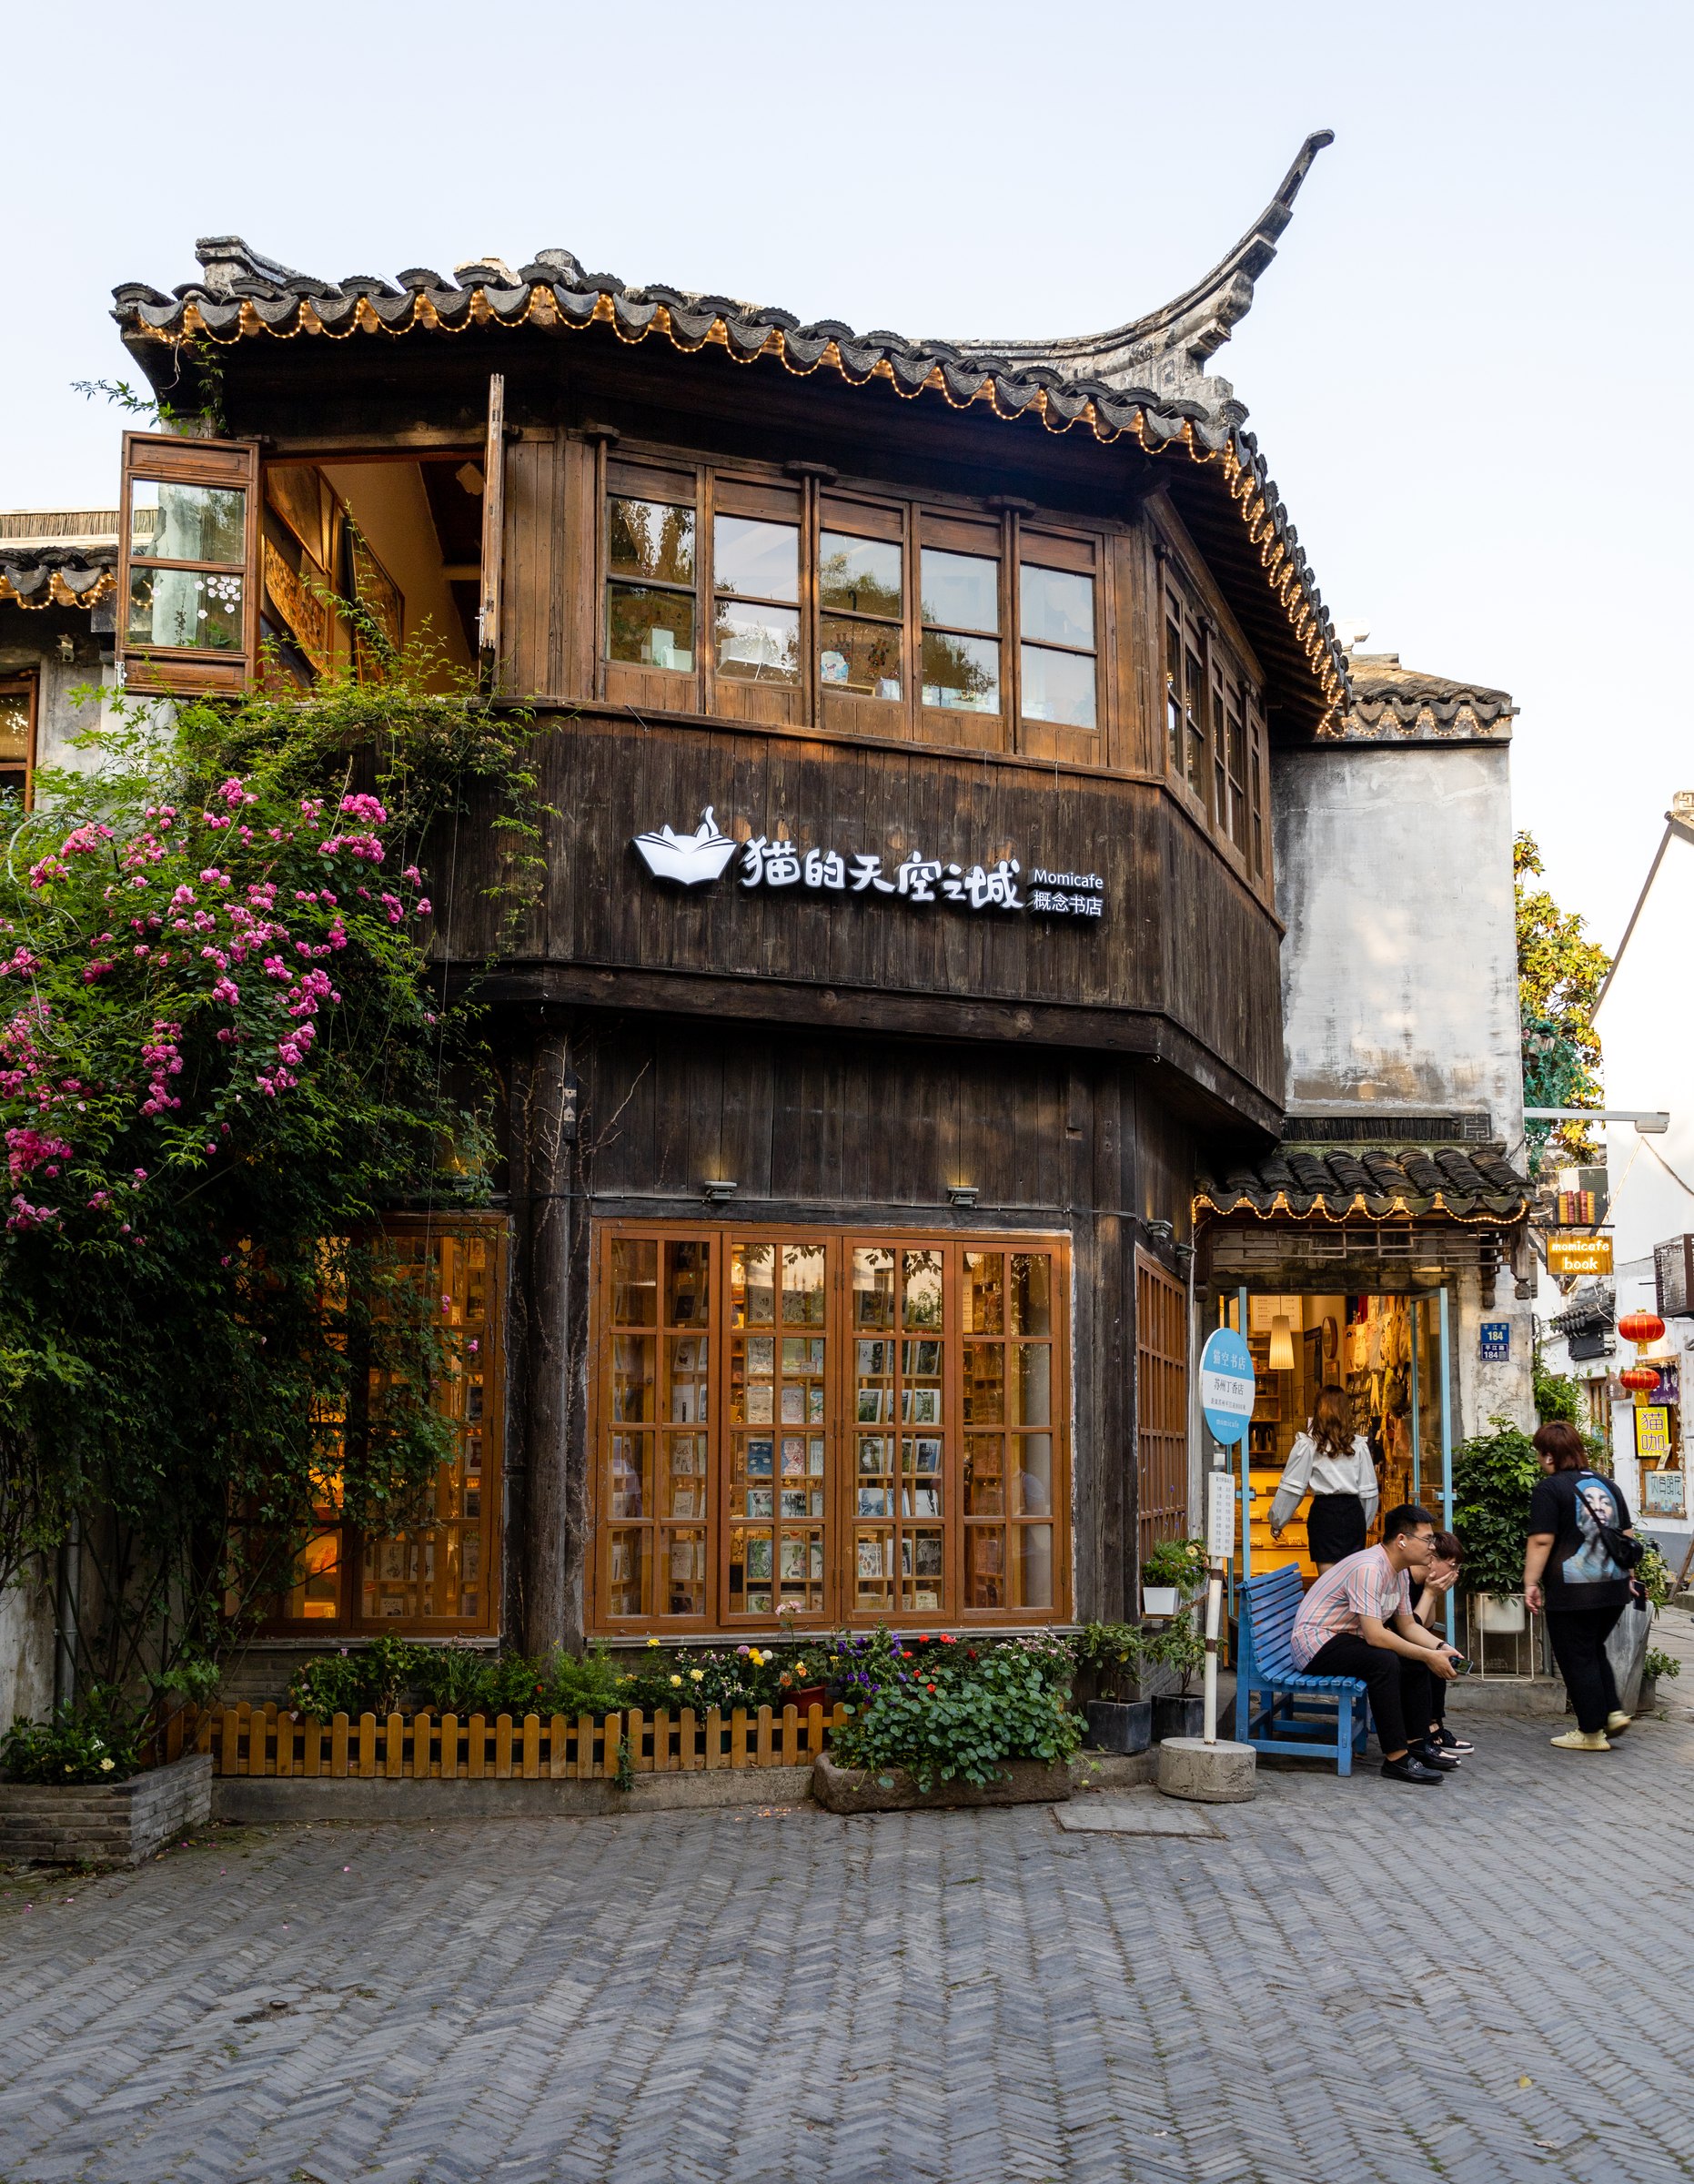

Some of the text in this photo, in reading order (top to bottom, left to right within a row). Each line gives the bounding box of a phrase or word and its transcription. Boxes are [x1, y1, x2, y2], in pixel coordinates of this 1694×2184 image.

[743, 834, 1023, 909] 猫的天空之城
[1034, 868, 1104, 889] Momicafe
[1034, 891, 1103, 917] 概念书店
[1551, 1239, 1609, 1251] momicafe
[1564, 1257, 1598, 1270] book
[1487, 1331, 1503, 1340] 184
[1213, 1349, 1245, 1370] 猫空书店
[1214, 1378, 1244, 1395] 苏州丁香店
[1640, 1412, 1664, 1451] 猫咖
